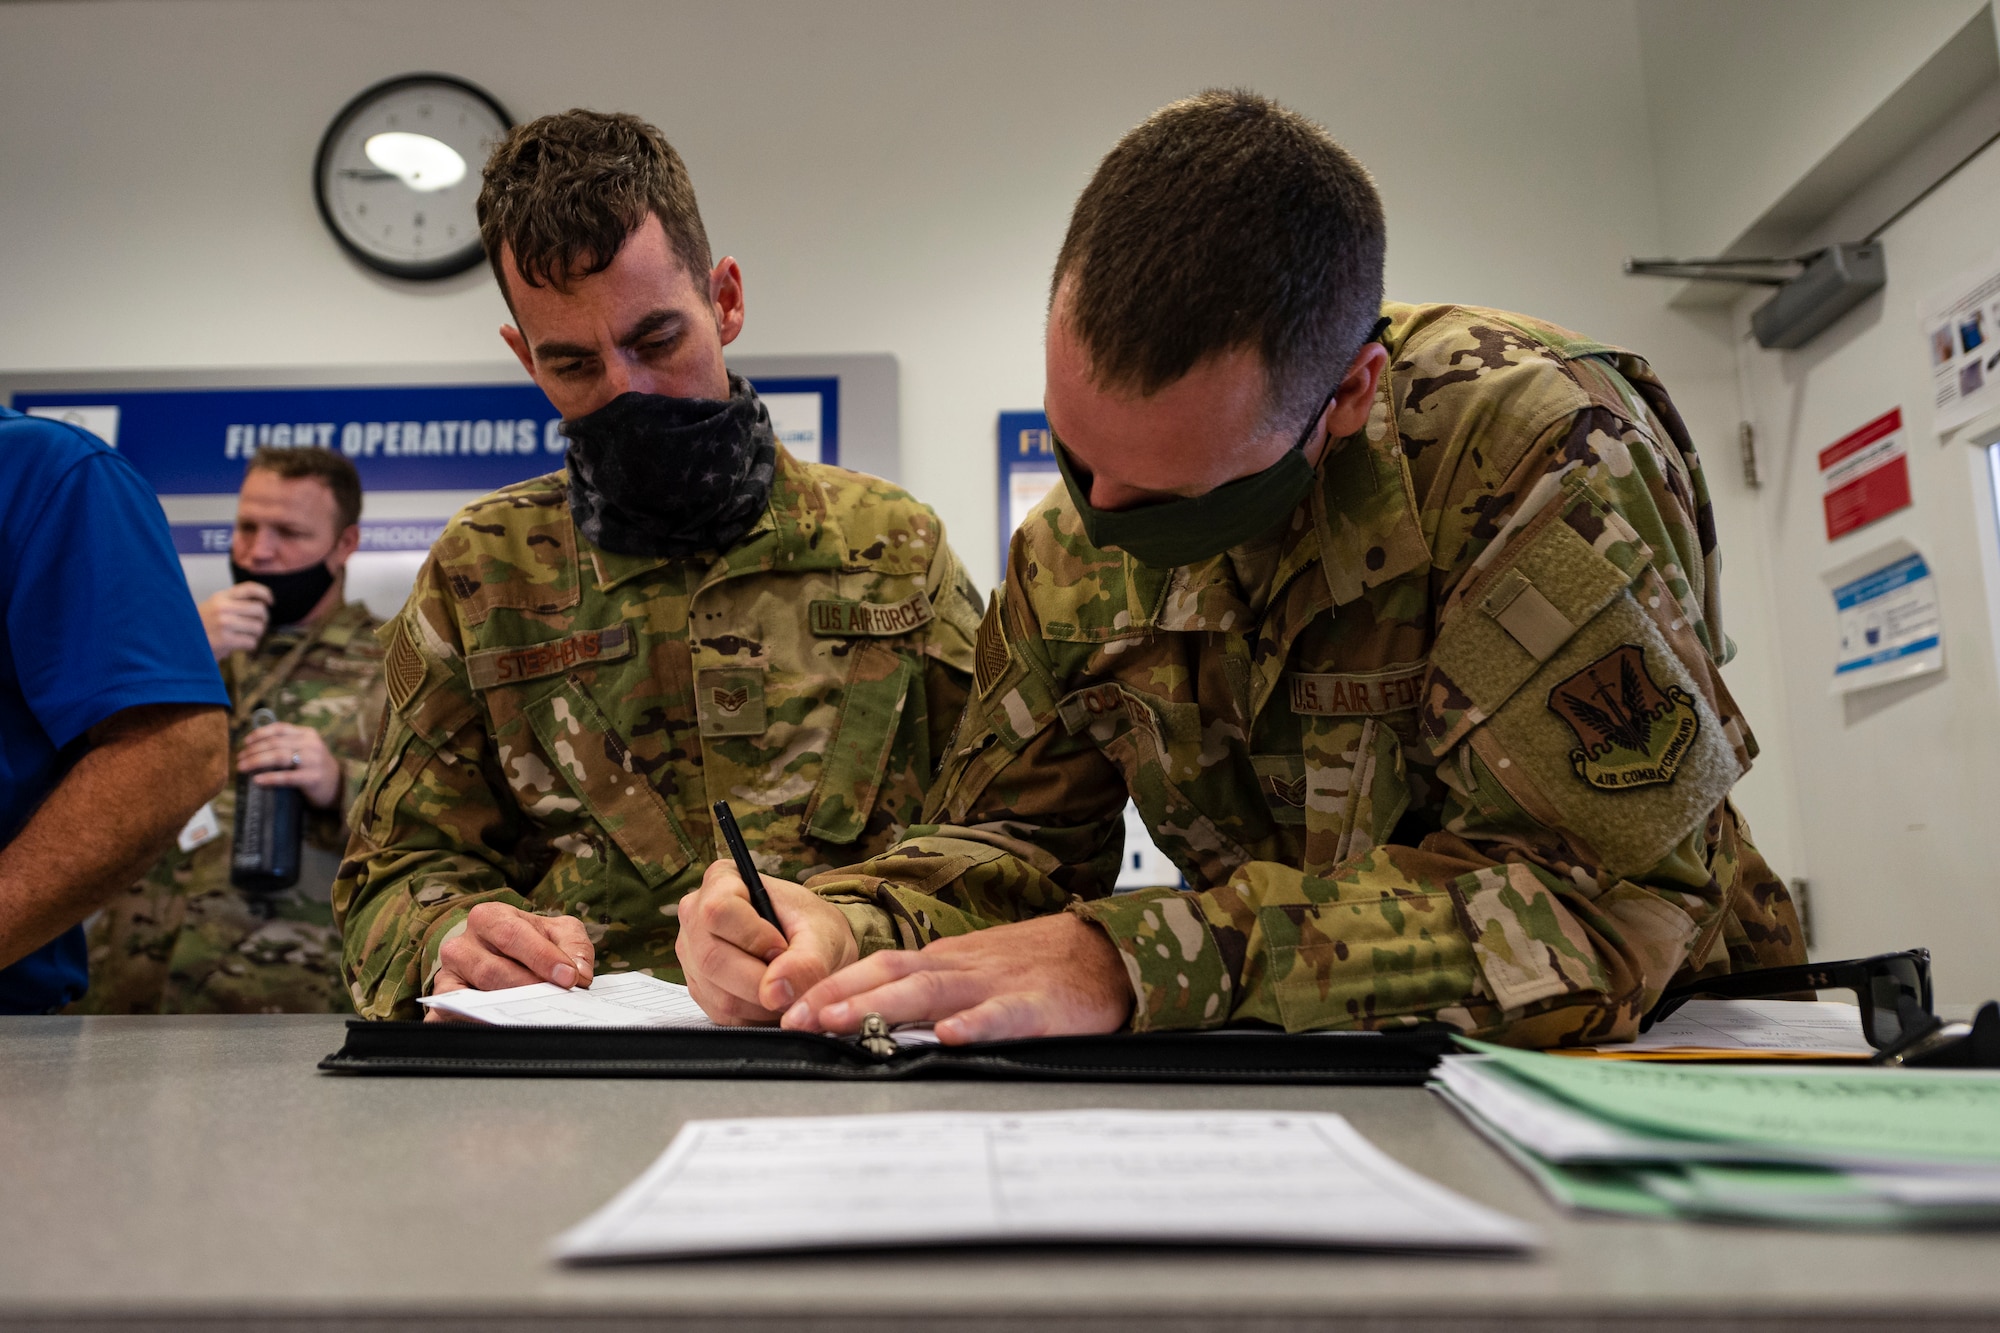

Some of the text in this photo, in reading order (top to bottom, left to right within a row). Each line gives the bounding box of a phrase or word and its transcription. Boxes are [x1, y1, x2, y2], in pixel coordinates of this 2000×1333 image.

[224, 423, 336, 459] FLIGHT
[341, 419, 537, 458] OPERATIONS
[848, 606, 875, 632] AIR
[872, 597, 927, 632] FORCE
[496, 634, 600, 679] STEPHENS
[1293, 679, 1323, 711] U.S.
[1332, 680, 1375, 713] AIR
[1595, 717, 1694, 785] AIR COMBAT COMMAND
